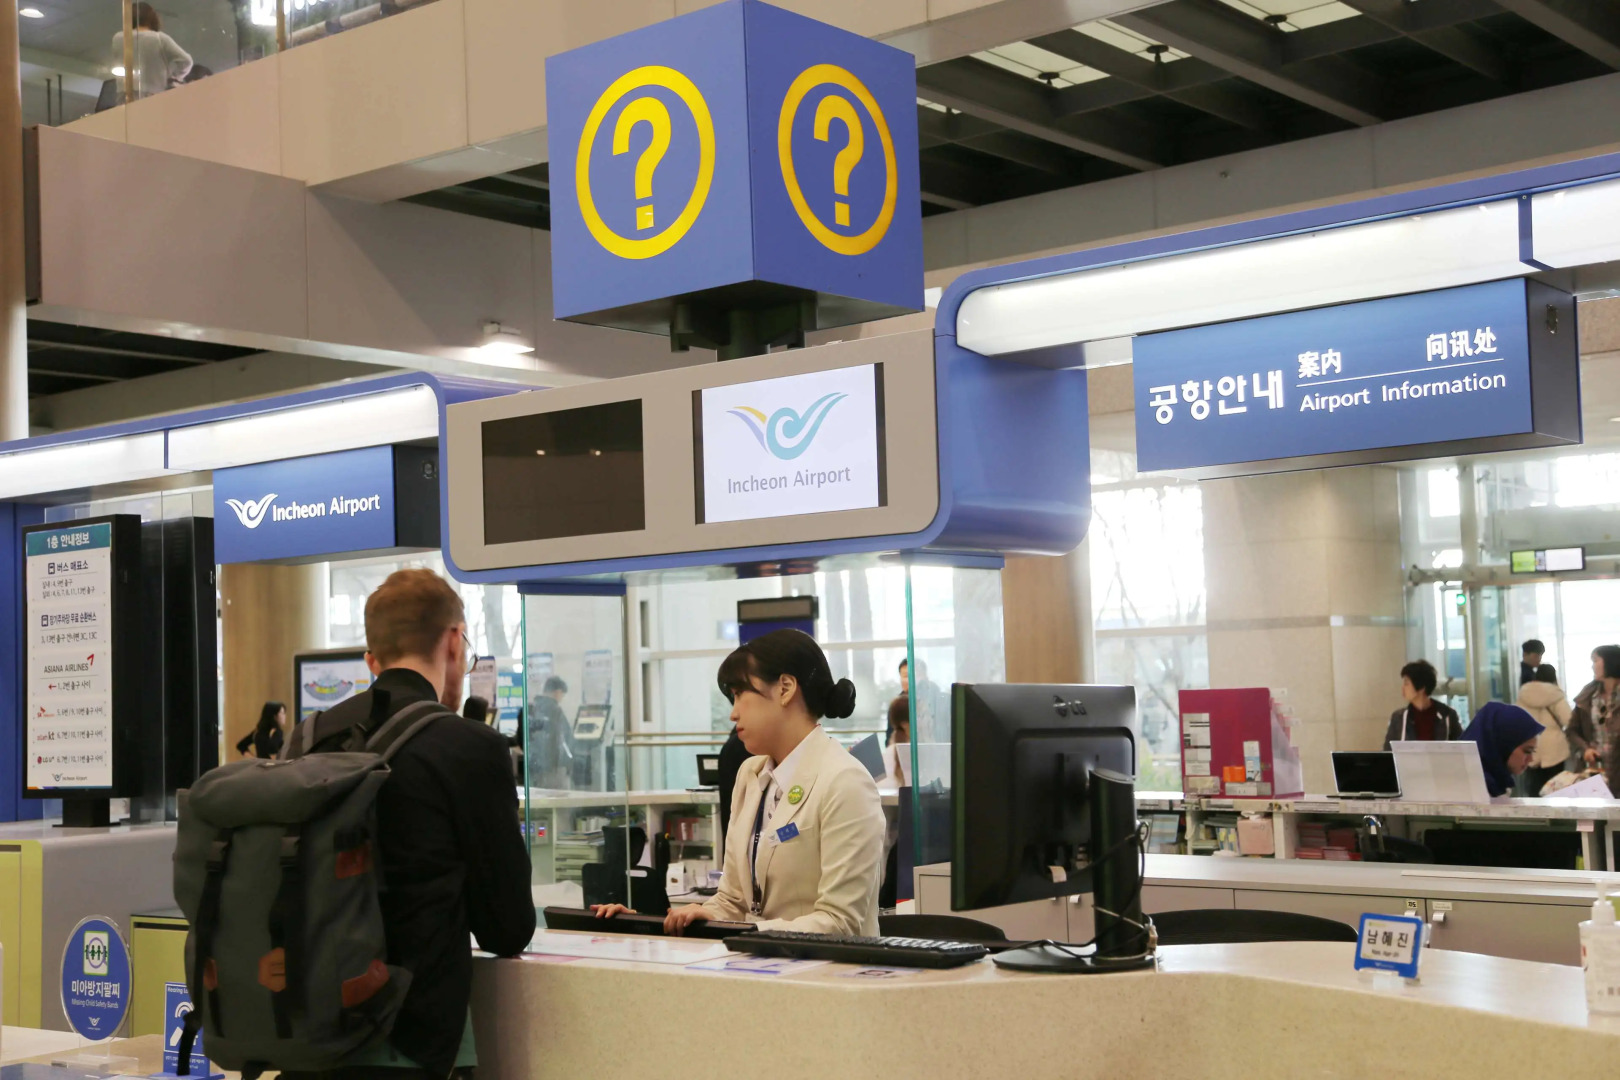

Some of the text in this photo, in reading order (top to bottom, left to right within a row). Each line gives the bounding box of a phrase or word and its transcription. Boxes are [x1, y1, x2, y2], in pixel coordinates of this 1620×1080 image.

[1426, 326, 1497, 362] 问讯处
[1298, 348, 1342, 379] 案内
[1149, 369, 1284, 425] 공항안내
[1299, 373, 1506, 413] Airport Information
[728, 466, 851, 494] Incheon Airport
[272, 494, 381, 522] Incheon Airport
[46, 532, 90, 549] 1층 안내정보
[57, 562, 69, 573] 버스
[44, 662, 89, 674] ASIANA AIRLINES
[71, 979, 120, 999] 미아방지팔찌
[167, 986, 183, 995] Hearing
